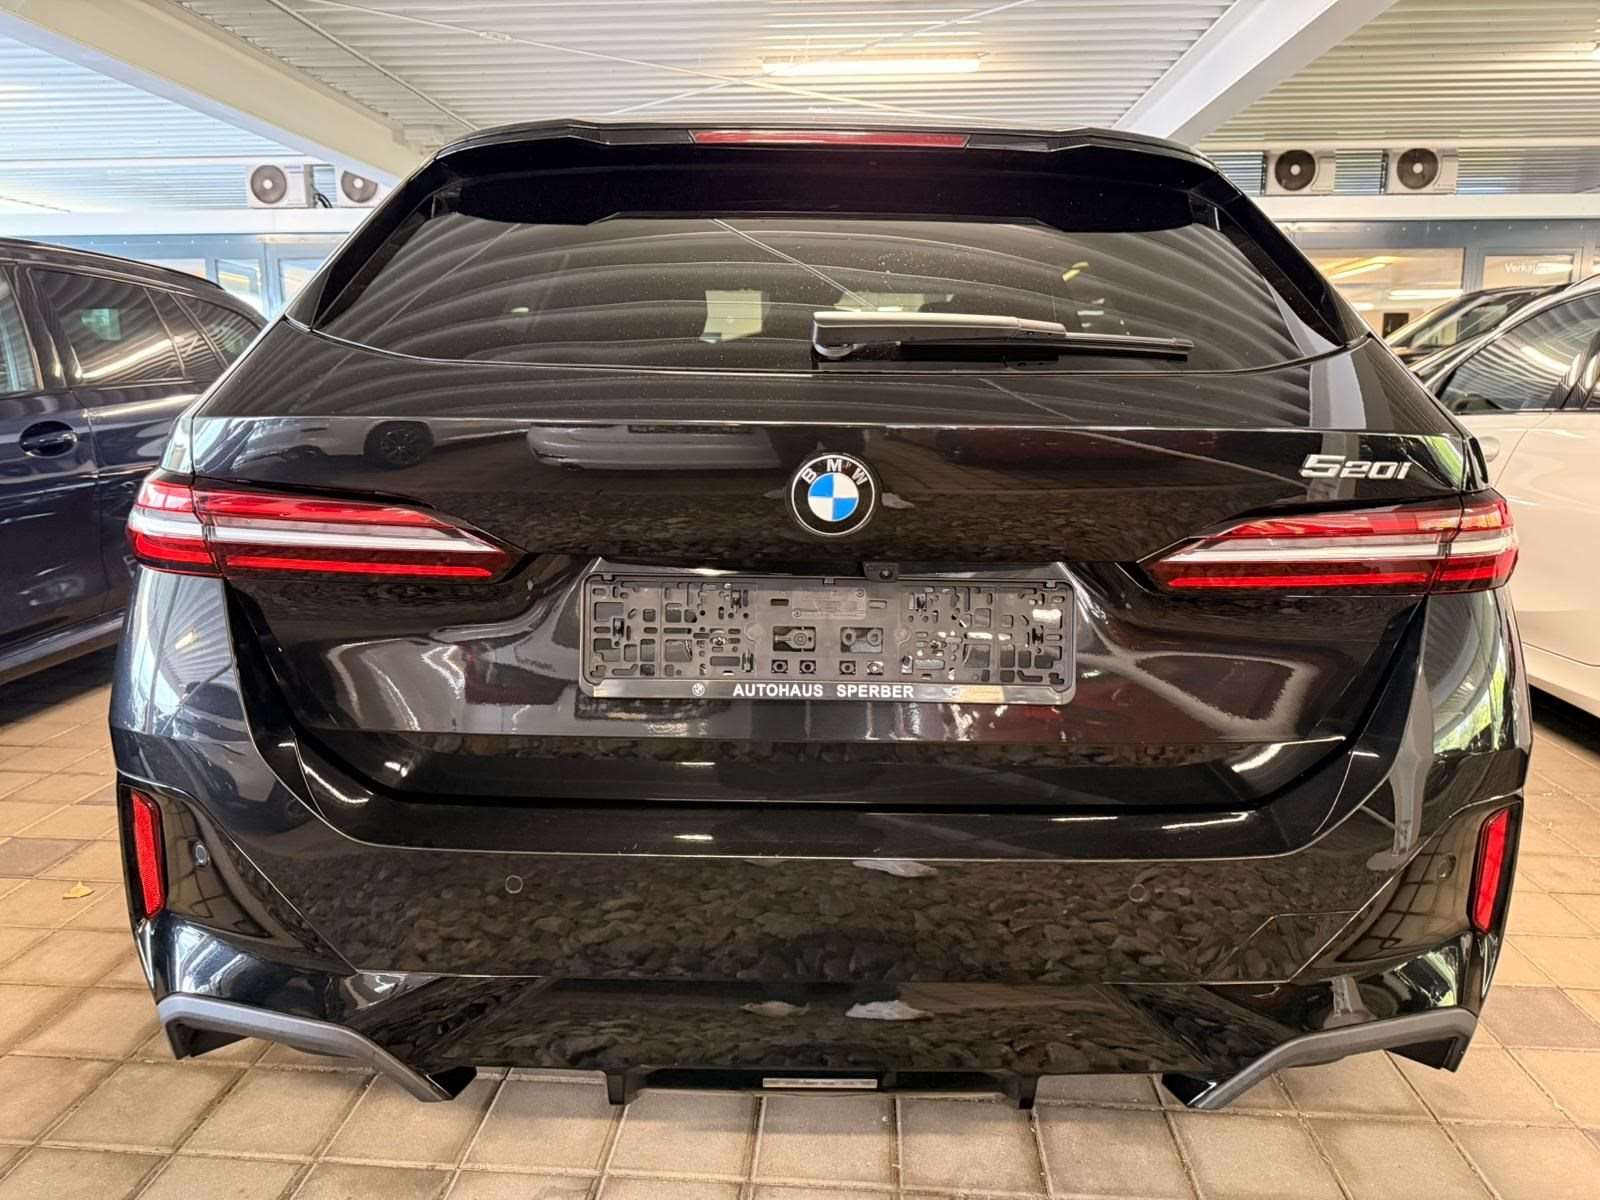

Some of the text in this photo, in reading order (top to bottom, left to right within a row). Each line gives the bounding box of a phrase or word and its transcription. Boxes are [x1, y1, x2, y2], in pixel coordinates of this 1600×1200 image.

[801, 459, 868, 485] BMW
[733, 683, 914, 698] AUTOHAUS SPERBER
